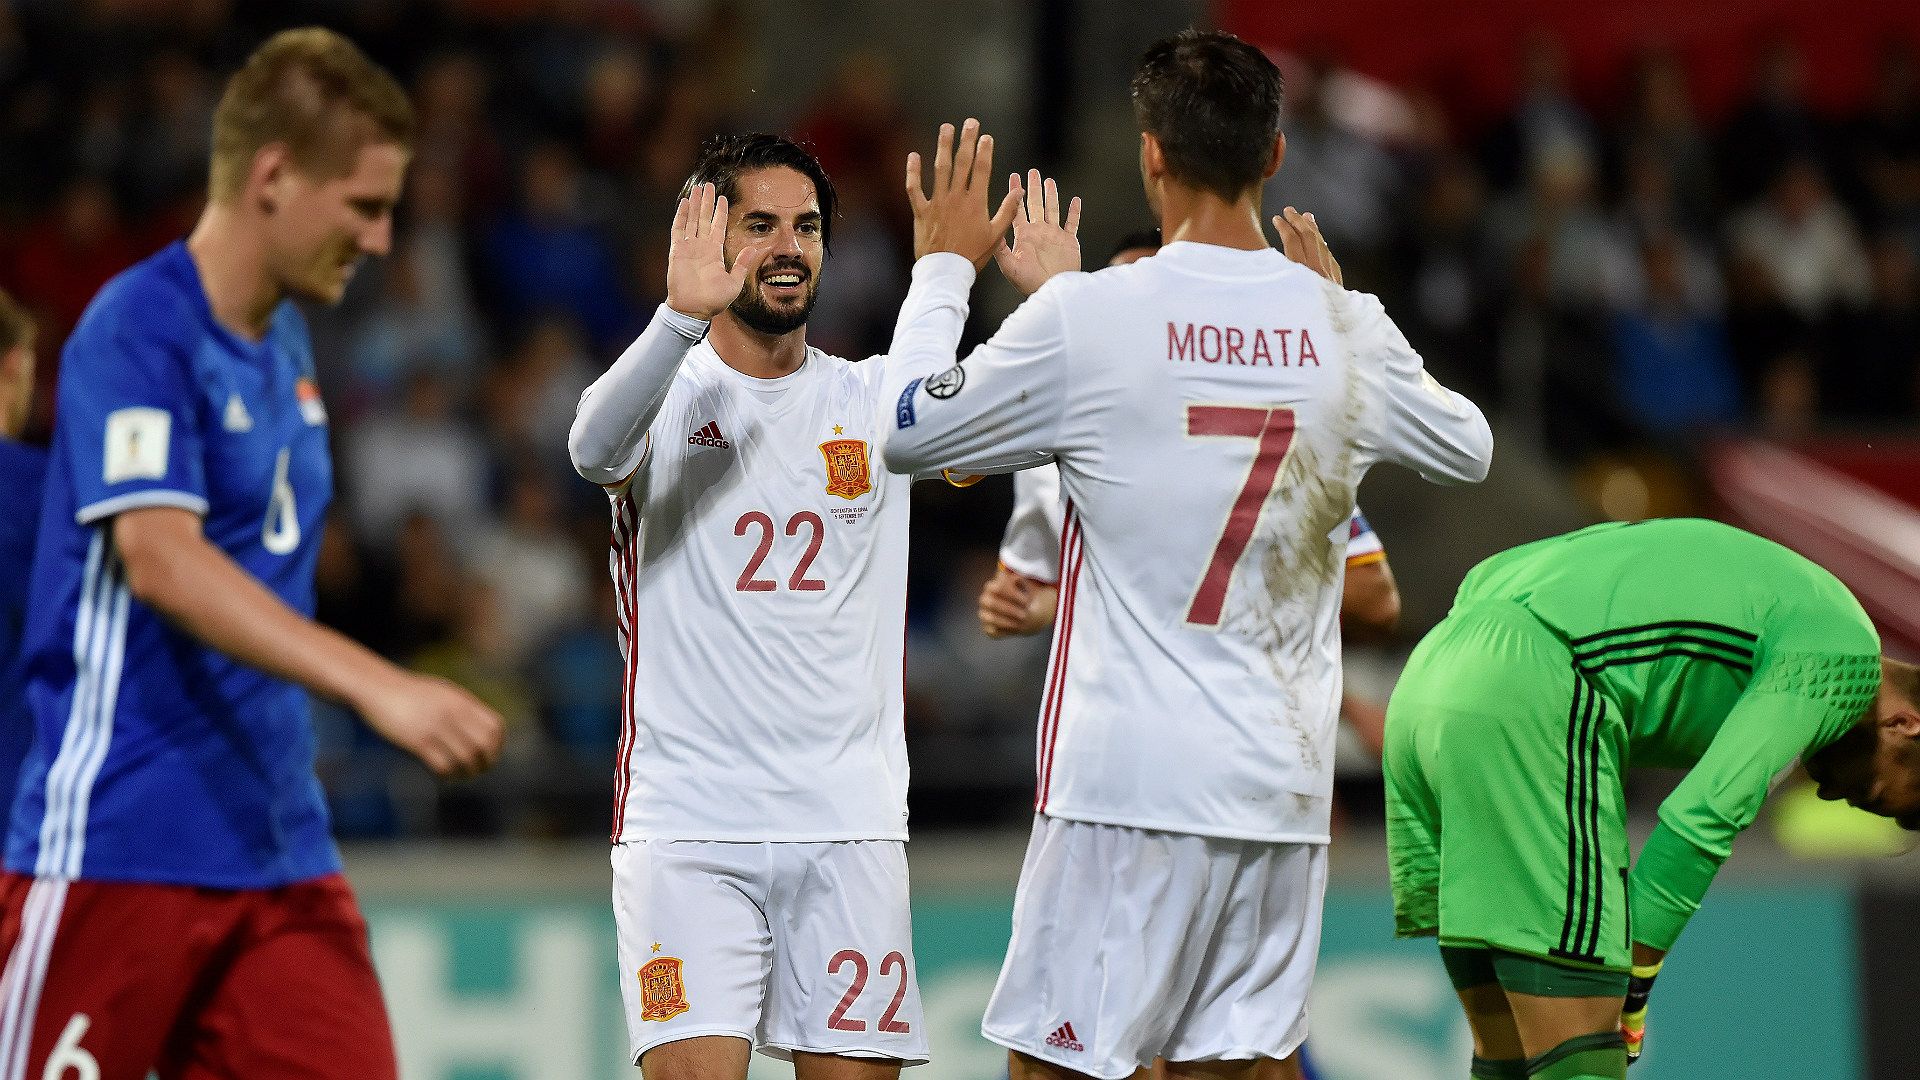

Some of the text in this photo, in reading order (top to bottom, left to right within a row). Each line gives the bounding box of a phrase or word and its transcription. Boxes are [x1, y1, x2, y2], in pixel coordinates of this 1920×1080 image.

[1166, 321, 1320, 367] MORATA
[687, 436, 730, 450] adidas
[262, 446, 301, 555] 6
[1184, 403, 1296, 627] 7
[733, 510, 827, 592] 22
[827, 949, 911, 1034] 22
[41, 1011, 101, 1080] 6
[1045, 1036, 1084, 1052] adidas
